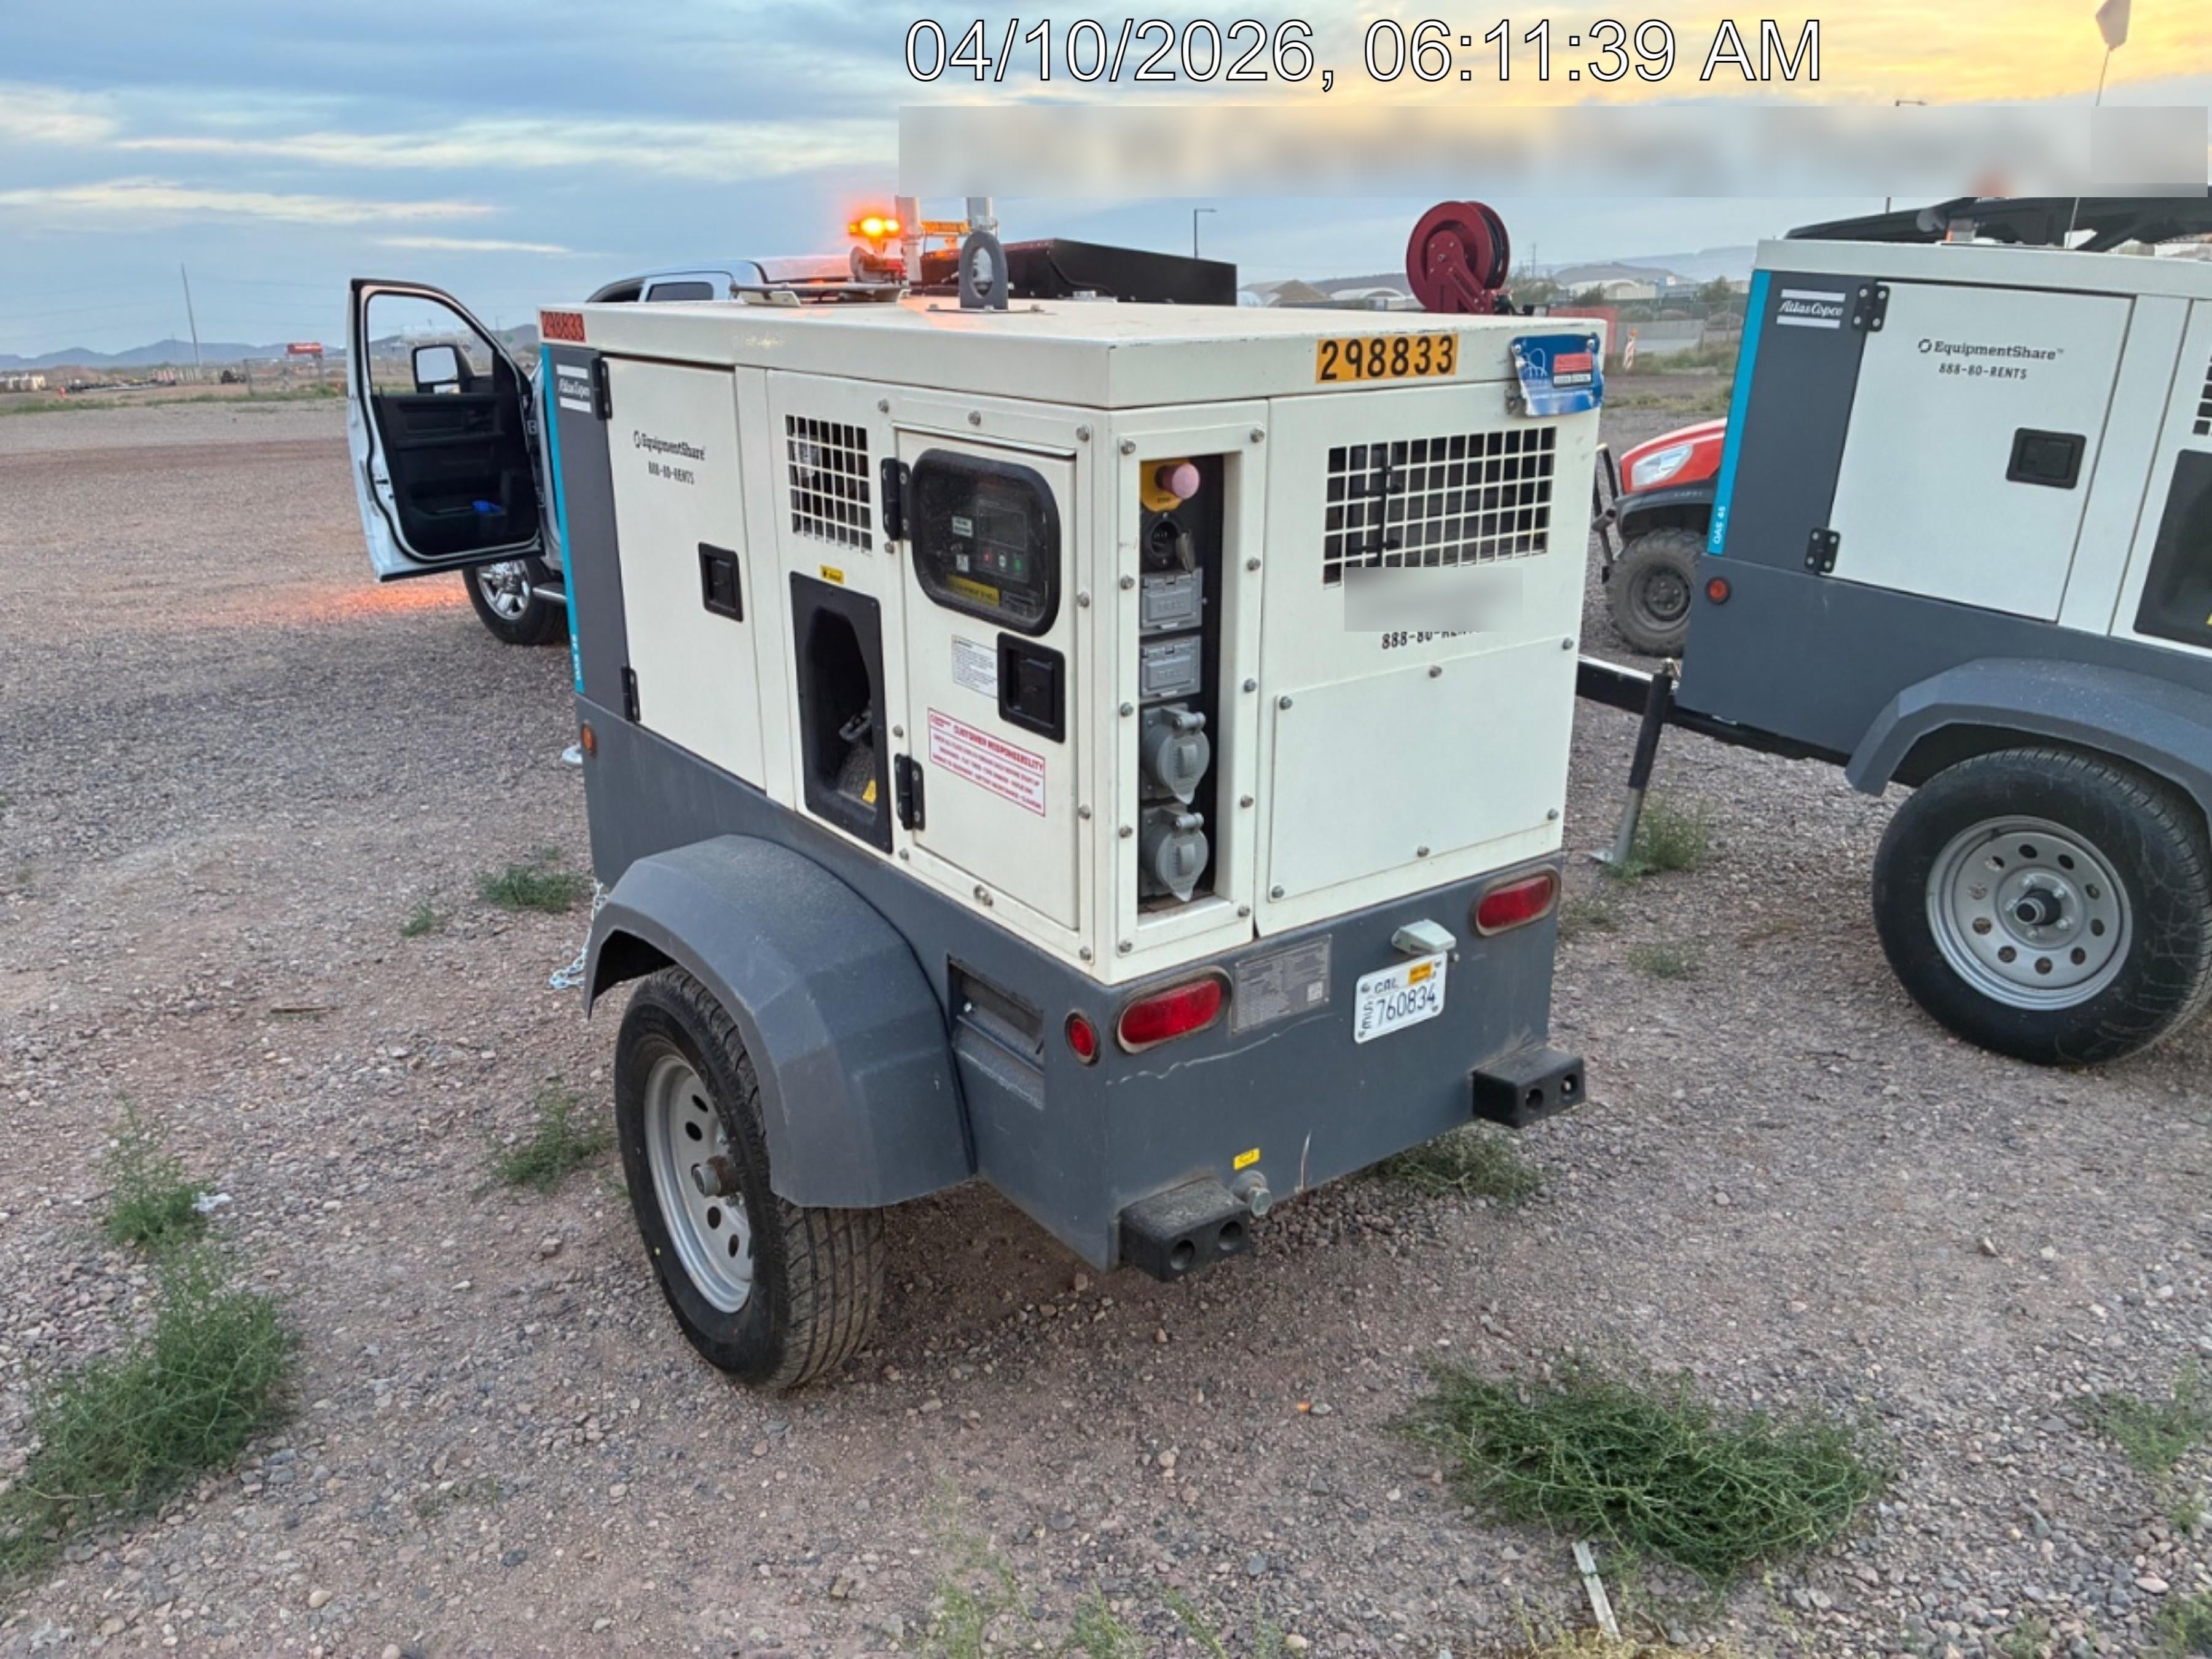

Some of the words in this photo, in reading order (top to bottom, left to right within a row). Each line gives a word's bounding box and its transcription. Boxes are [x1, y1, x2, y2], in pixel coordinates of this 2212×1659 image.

[1319, 335, 1454, 380] 298833
[1939, 363, 2028, 380] 888-80-RENTS
[1376, 984, 1435, 1027] 760834
